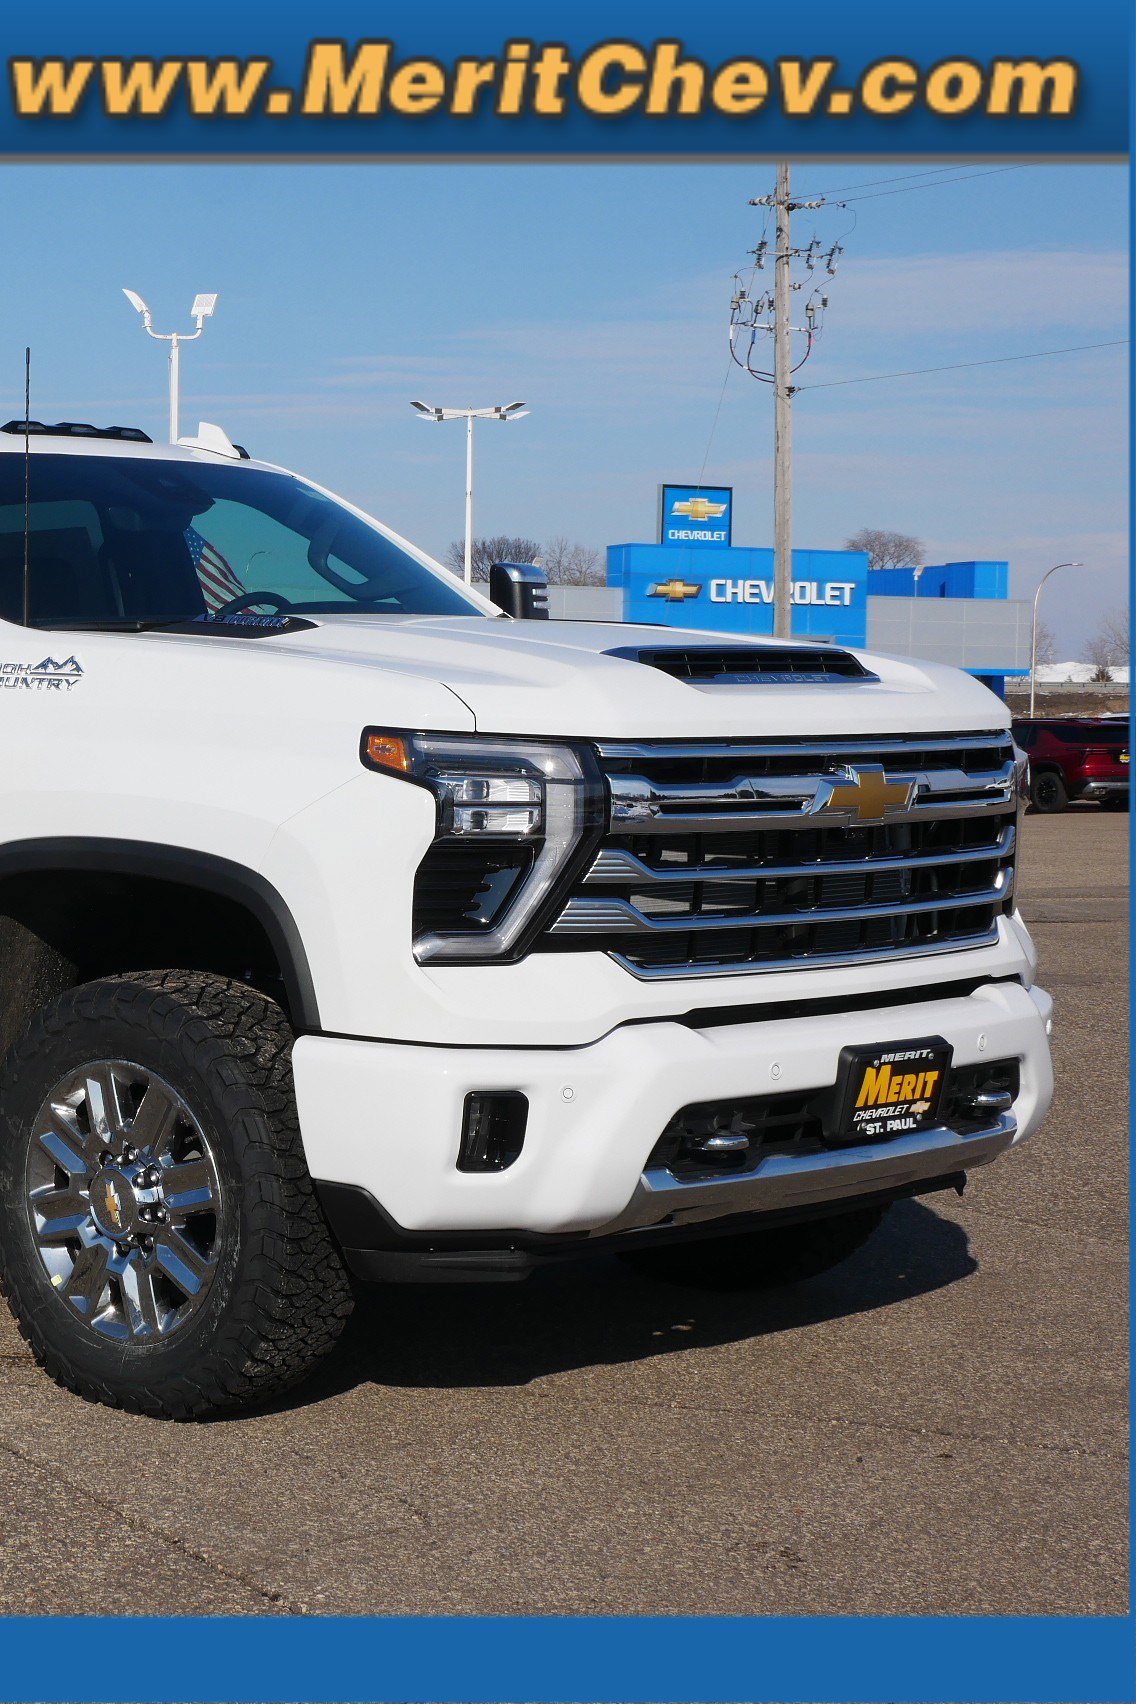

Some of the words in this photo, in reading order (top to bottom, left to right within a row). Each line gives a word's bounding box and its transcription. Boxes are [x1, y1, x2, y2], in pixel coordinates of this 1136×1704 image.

[668, 529, 727, 541] CHEVROLET
[881, 1049, 930, 1062] MERIT
[855, 1065, 938, 1107] MERIT
[853, 1105, 909, 1121] CHEVROLET
[865, 1122, 884, 1135] ST.
[886, 1118, 916, 1131] PAUL
